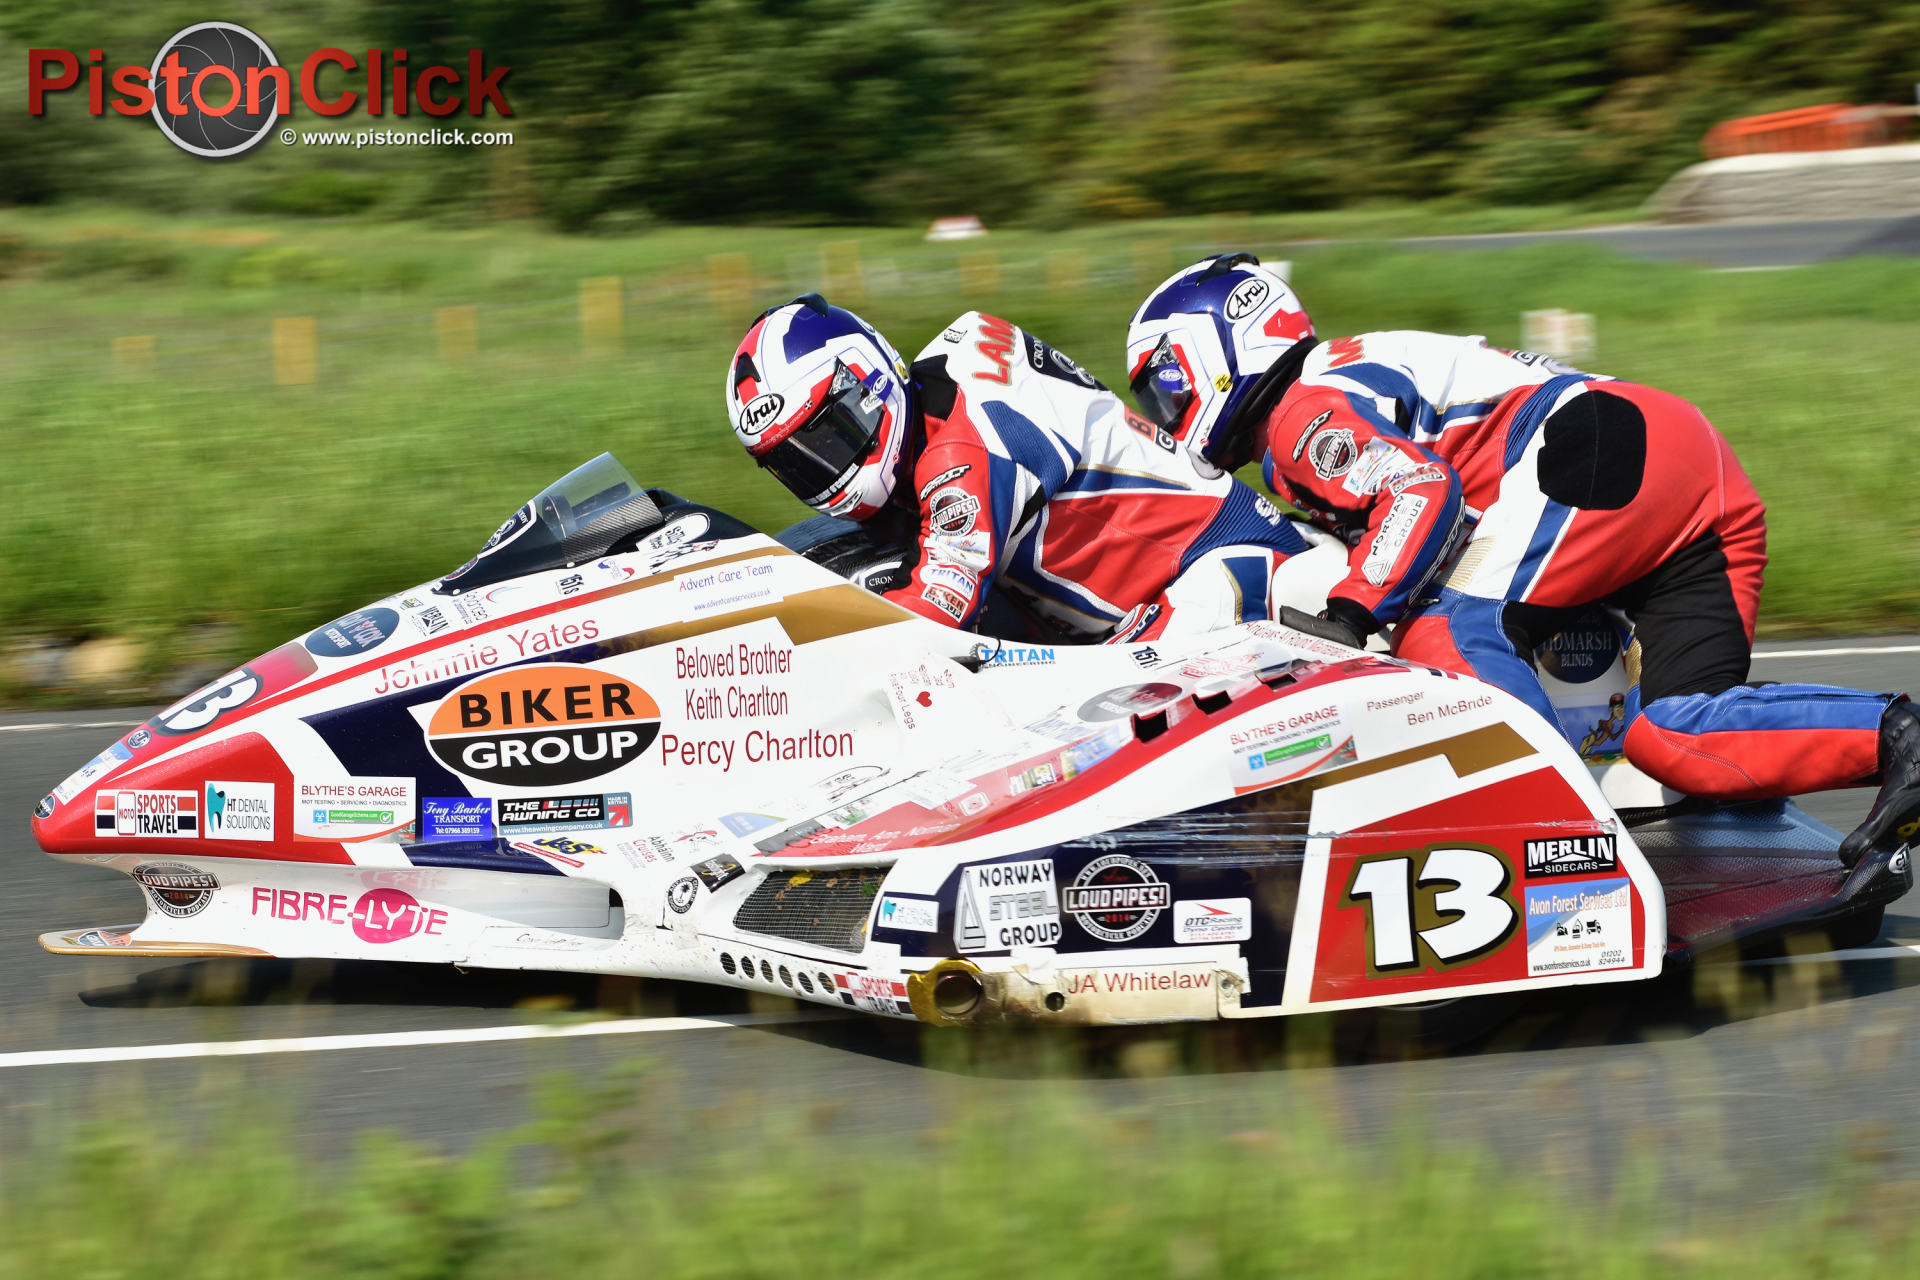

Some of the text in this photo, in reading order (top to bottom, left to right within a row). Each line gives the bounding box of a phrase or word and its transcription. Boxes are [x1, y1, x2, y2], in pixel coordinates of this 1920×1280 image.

[1227, 280, 1265, 319] Arai
[743, 394, 778, 433] Arai
[679, 564, 774, 592] Advent Care Team
[931, 568, 973, 592] TRITAN
[375, 619, 600, 695] Johnnie Yates
[676, 642, 793, 679] Beloved Brother
[981, 648, 1055, 663] TRITAN
[1561, 654, 1594, 667] BLINDS
[460, 683, 635, 728] BIKER
[685, 684, 788, 720] Keith Charlton
[1366, 691, 1425, 711] Passenger
[1407, 695, 1492, 726] Ben McBride
[902, 703, 917, 730] Legs
[1229, 705, 1339, 745] BLYTHE'S GARAGE
[462, 731, 638, 769] GROUP
[661, 729, 853, 772] Percy Charlton
[301, 785, 407, 797] BLYTHE'S GARAGE
[119, 808, 135, 820] MOTO
[137, 794, 176, 814] SPORTS
[227, 798, 268, 813] HT DENTAL
[424, 801, 491, 818] Tony Barker
[502, 808, 600, 822] AWNING CO
[504, 801, 540, 812] THE
[137, 815, 177, 834] TRAVEL
[226, 815, 271, 830] SOLUTIONS
[434, 815, 481, 823] TRANSPORT
[502, 822, 603, 834] www.theawningcompany.co.uk
[632, 838, 658, 863] Cruises
[1526, 837, 1614, 868] MERLIN
[980, 863, 1052, 887] NORWAY
[1545, 861, 1598, 874] SIDECARS
[170, 875, 214, 888] PIPES!
[187, 891, 210, 914] PODCAST
[990, 890, 1059, 921] STEEL
[1069, 886, 1165, 909] LOUD PIPES!
[1529, 888, 1628, 916] Avon Forest Services Ltd
[252, 886, 449, 936] FIBRE-LYTE
[1105, 913, 1130, 923] 2014
[1349, 849, 1517, 971] 13
[1000, 922, 1060, 946] GROUP
[1533, 958, 1591, 972] www.avonforestservices.co.uk
[1598, 957, 1625, 966] 824944
[1601, 950, 1622, 958] 01202
[1068, 970, 1211, 994] JA Whitelaw
